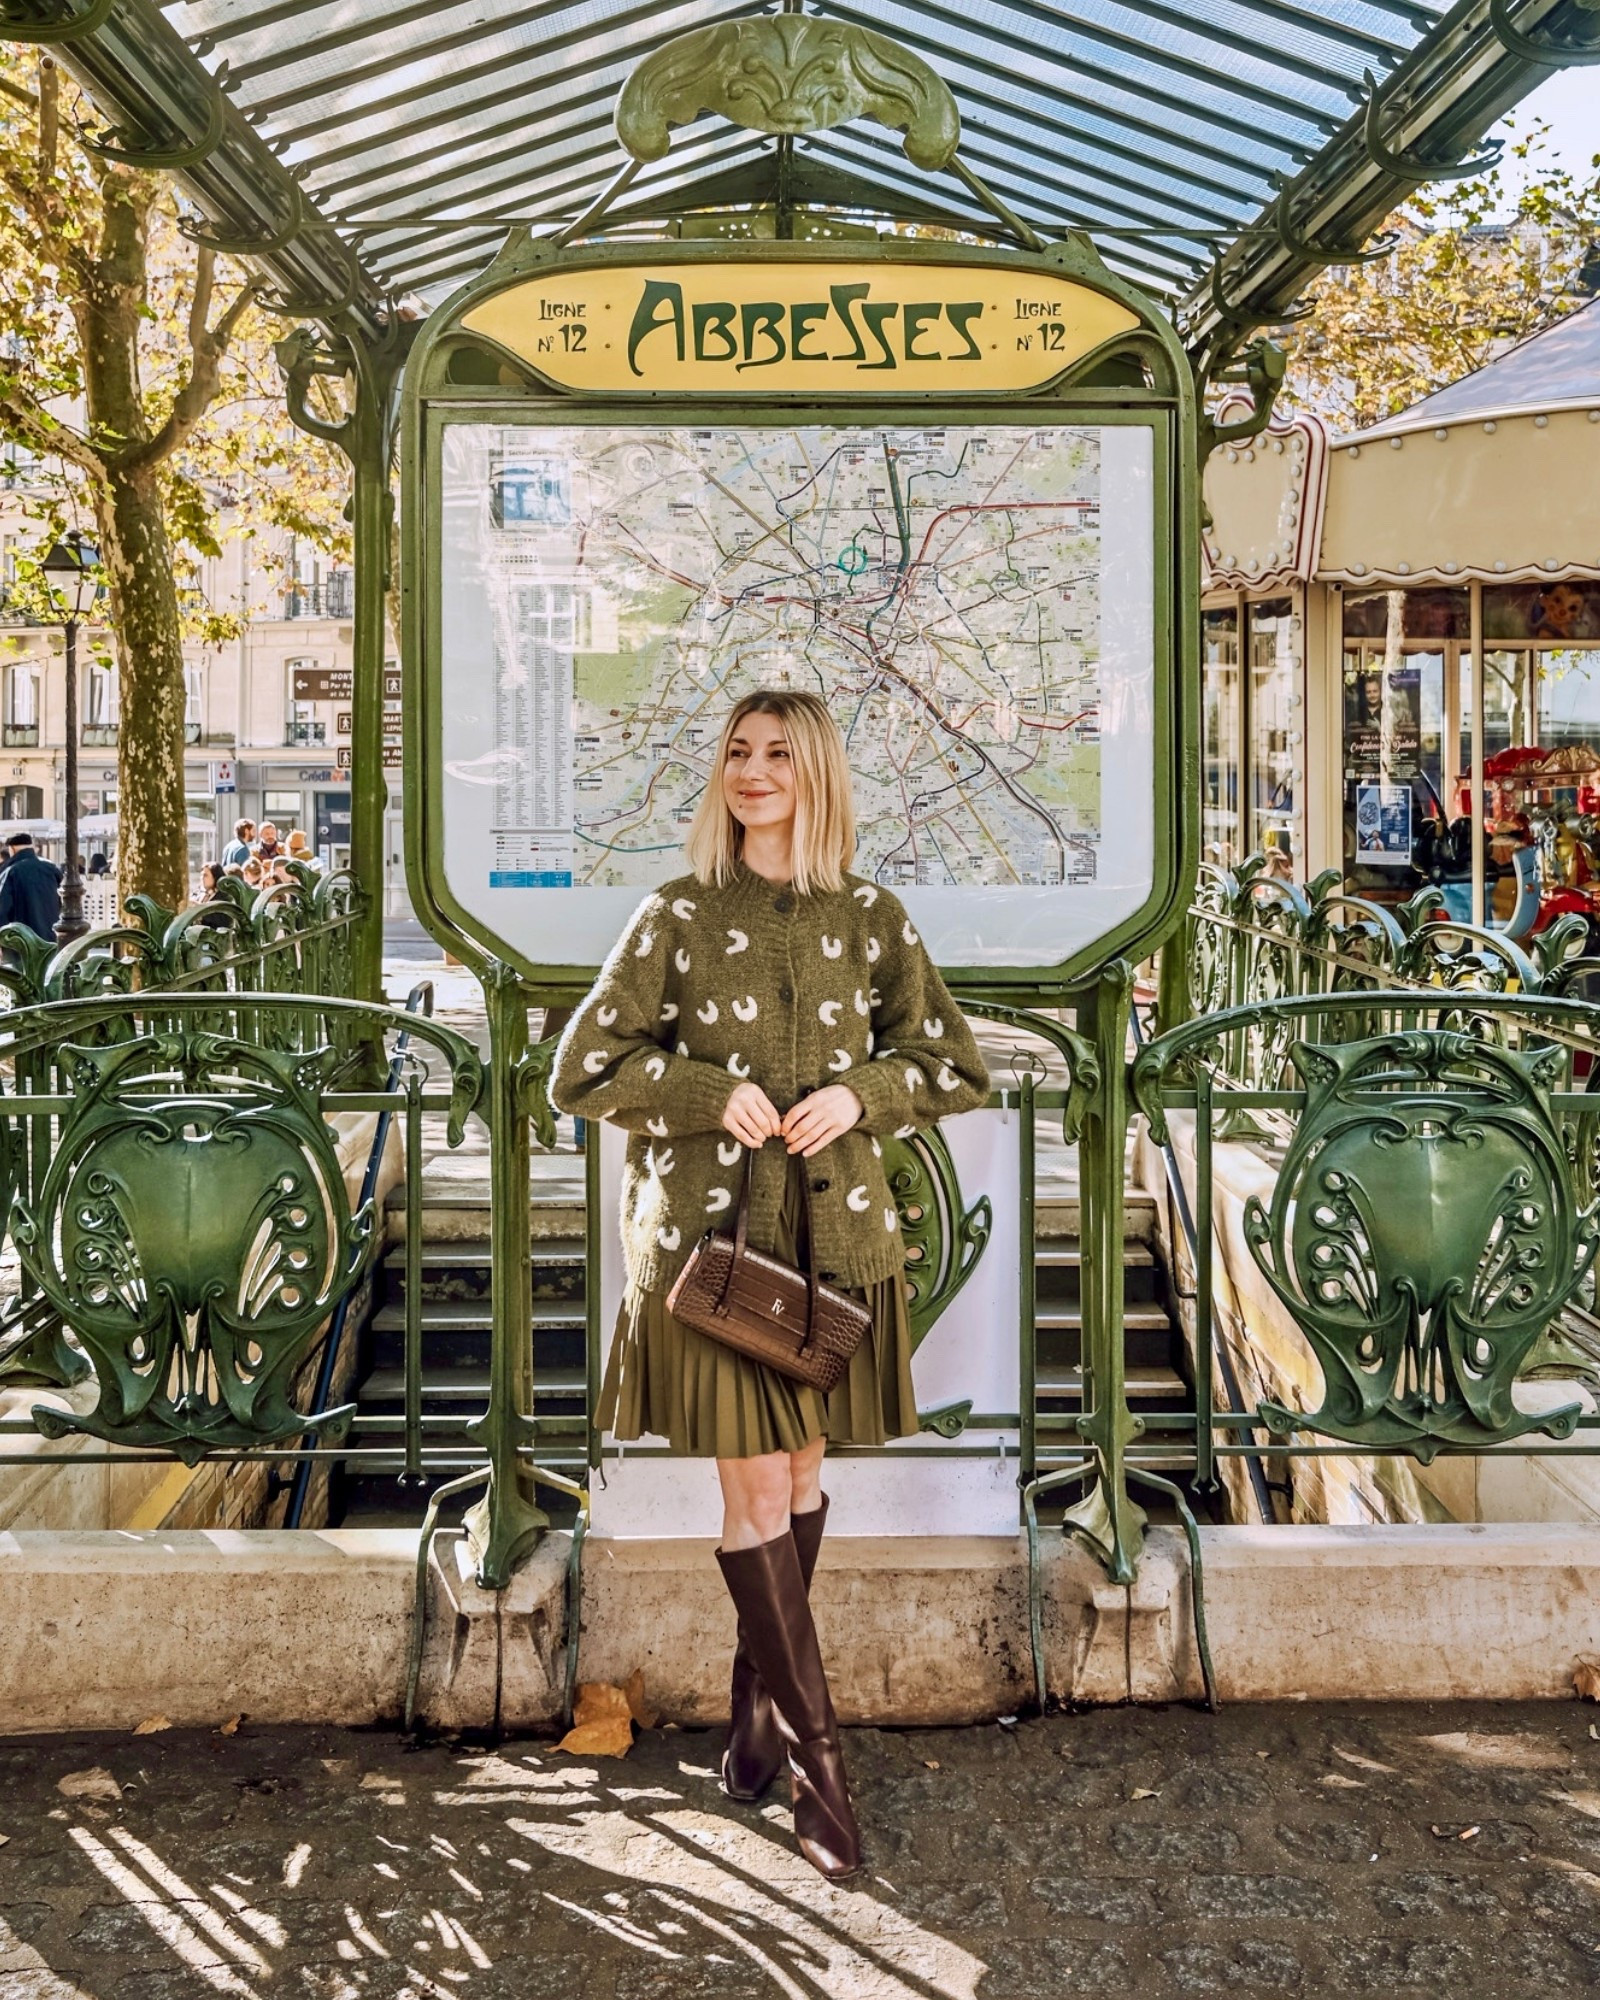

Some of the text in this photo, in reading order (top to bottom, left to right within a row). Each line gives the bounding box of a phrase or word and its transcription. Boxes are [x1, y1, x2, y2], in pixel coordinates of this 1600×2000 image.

[558, 324, 587, 353] 12
[628, 280, 984, 376] ABBESSES
[1037, 323, 1066, 352] 12
